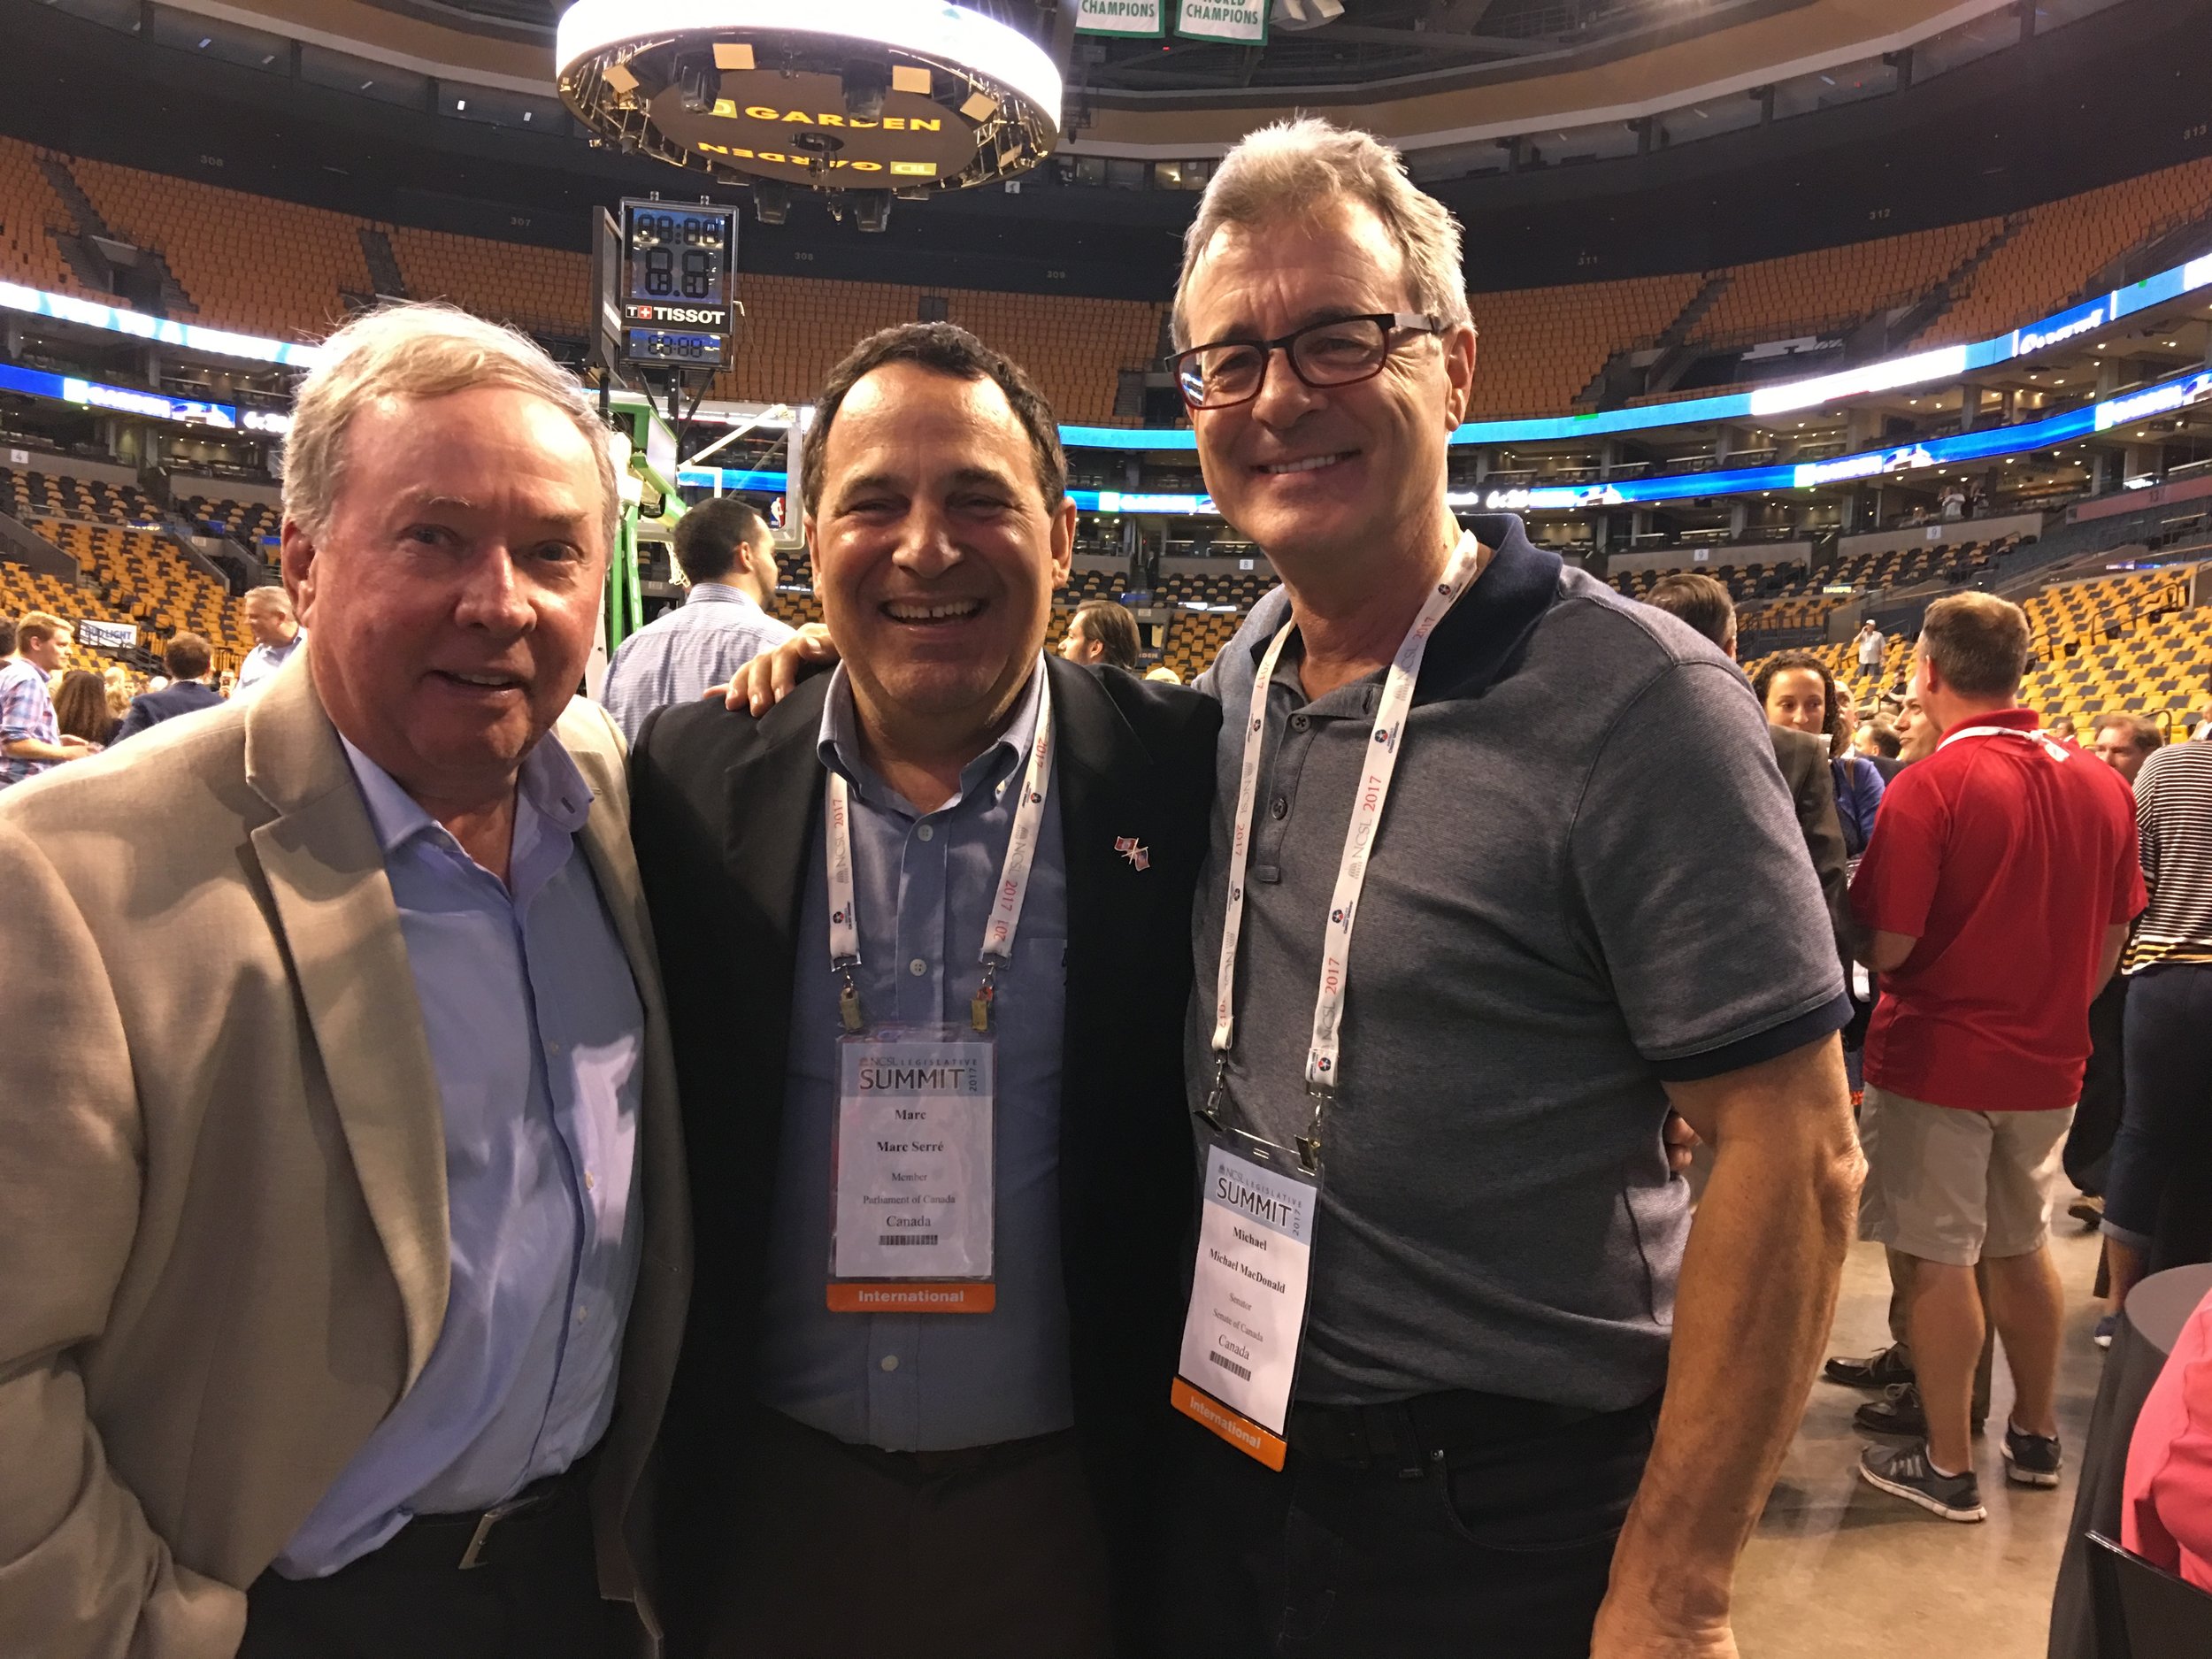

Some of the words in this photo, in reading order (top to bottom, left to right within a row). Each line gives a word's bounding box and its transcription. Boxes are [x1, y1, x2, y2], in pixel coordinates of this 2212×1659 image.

[1081, 0, 1155, 18] CHAMPIONS
[1187, 4, 1258, 25] CHAMPIONS
[511, 216, 532, 227] 307
[795, 251, 814, 261] 308
[653, 306, 726, 325] TISSOT
[106, 629, 132, 640] LIGHT
[1035, 736, 1048, 769] 2017
[833, 798, 844, 829] 2017
[1352, 818, 1373, 859] NCSL
[1363, 775, 1382, 812] 2017
[836, 831, 846, 869] NCSL
[1235, 823, 1246, 856] 2017
[1001, 879, 1018, 912] 2017
[1325, 957, 1340, 995] 2017
[1322, 1002, 1336, 1041] NCSL
[859, 1069, 965, 1090] SUMMIT
[969, 1067, 978, 1092] 2017
[895, 1110, 927, 1120] Marc
[877, 1141, 909, 1152] Marc
[911, 1141, 944, 1152] Serré
[892, 1171, 927, 1182] Member
[863, 1194, 910, 1204] Parliament
[911, 1194, 922, 1203] of
[924, 1194, 956, 1203] Canada
[1217, 1177, 1292, 1226] SUMMIT
[1246, 1179, 1302, 1208] LEGISLATIVE
[886, 1215, 932, 1227] Canada
[1292, 1209, 1301, 1237] 2017
[1233, 1225, 1267, 1251] Michael
[1210, 1248, 1239, 1271] Michael
[1240, 1263, 1286, 1294] MacDonald
[858, 1290, 964, 1303] International
[1229, 1292, 1253, 1311] Senator
[1212, 1308, 1232, 1325] Senate
[1233, 1320, 1240, 1330] of
[1240, 1324, 1263, 1343] Canada
[1218, 1334, 1250, 1361] Canada
[1189, 1395, 1262, 1450] International
